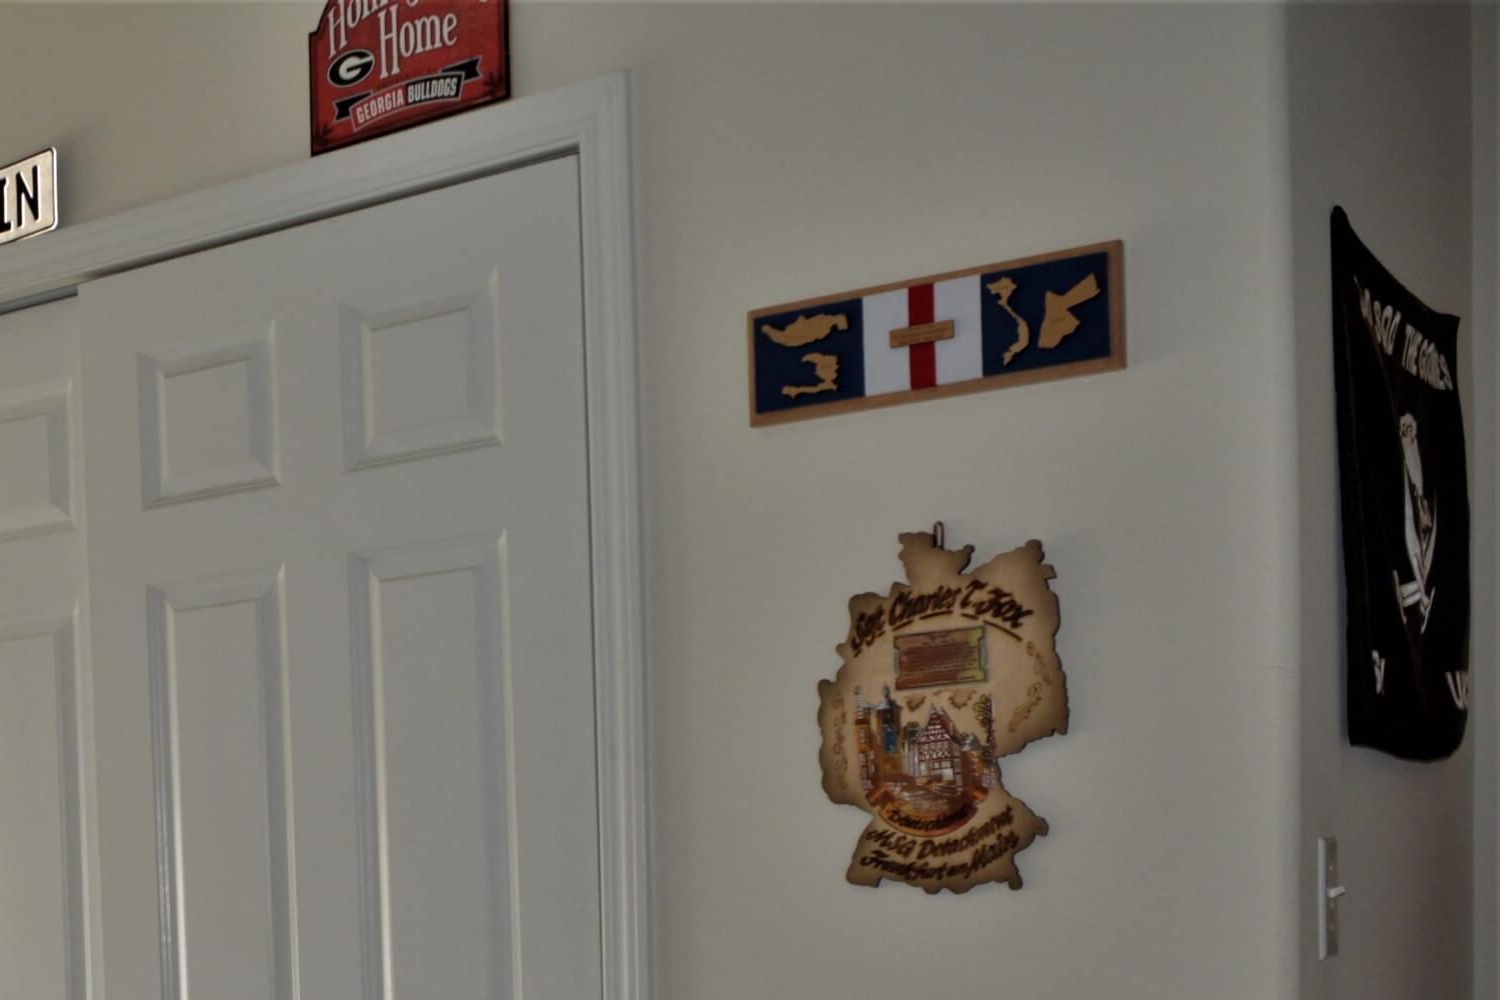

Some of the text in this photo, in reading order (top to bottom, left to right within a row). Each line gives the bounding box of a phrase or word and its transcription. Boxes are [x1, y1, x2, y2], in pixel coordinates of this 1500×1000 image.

[378, 5, 457, 80] Home
[356, 77, 457, 123] GEORGIA BULLDOGS
[888, 585, 961, 626] Charles
